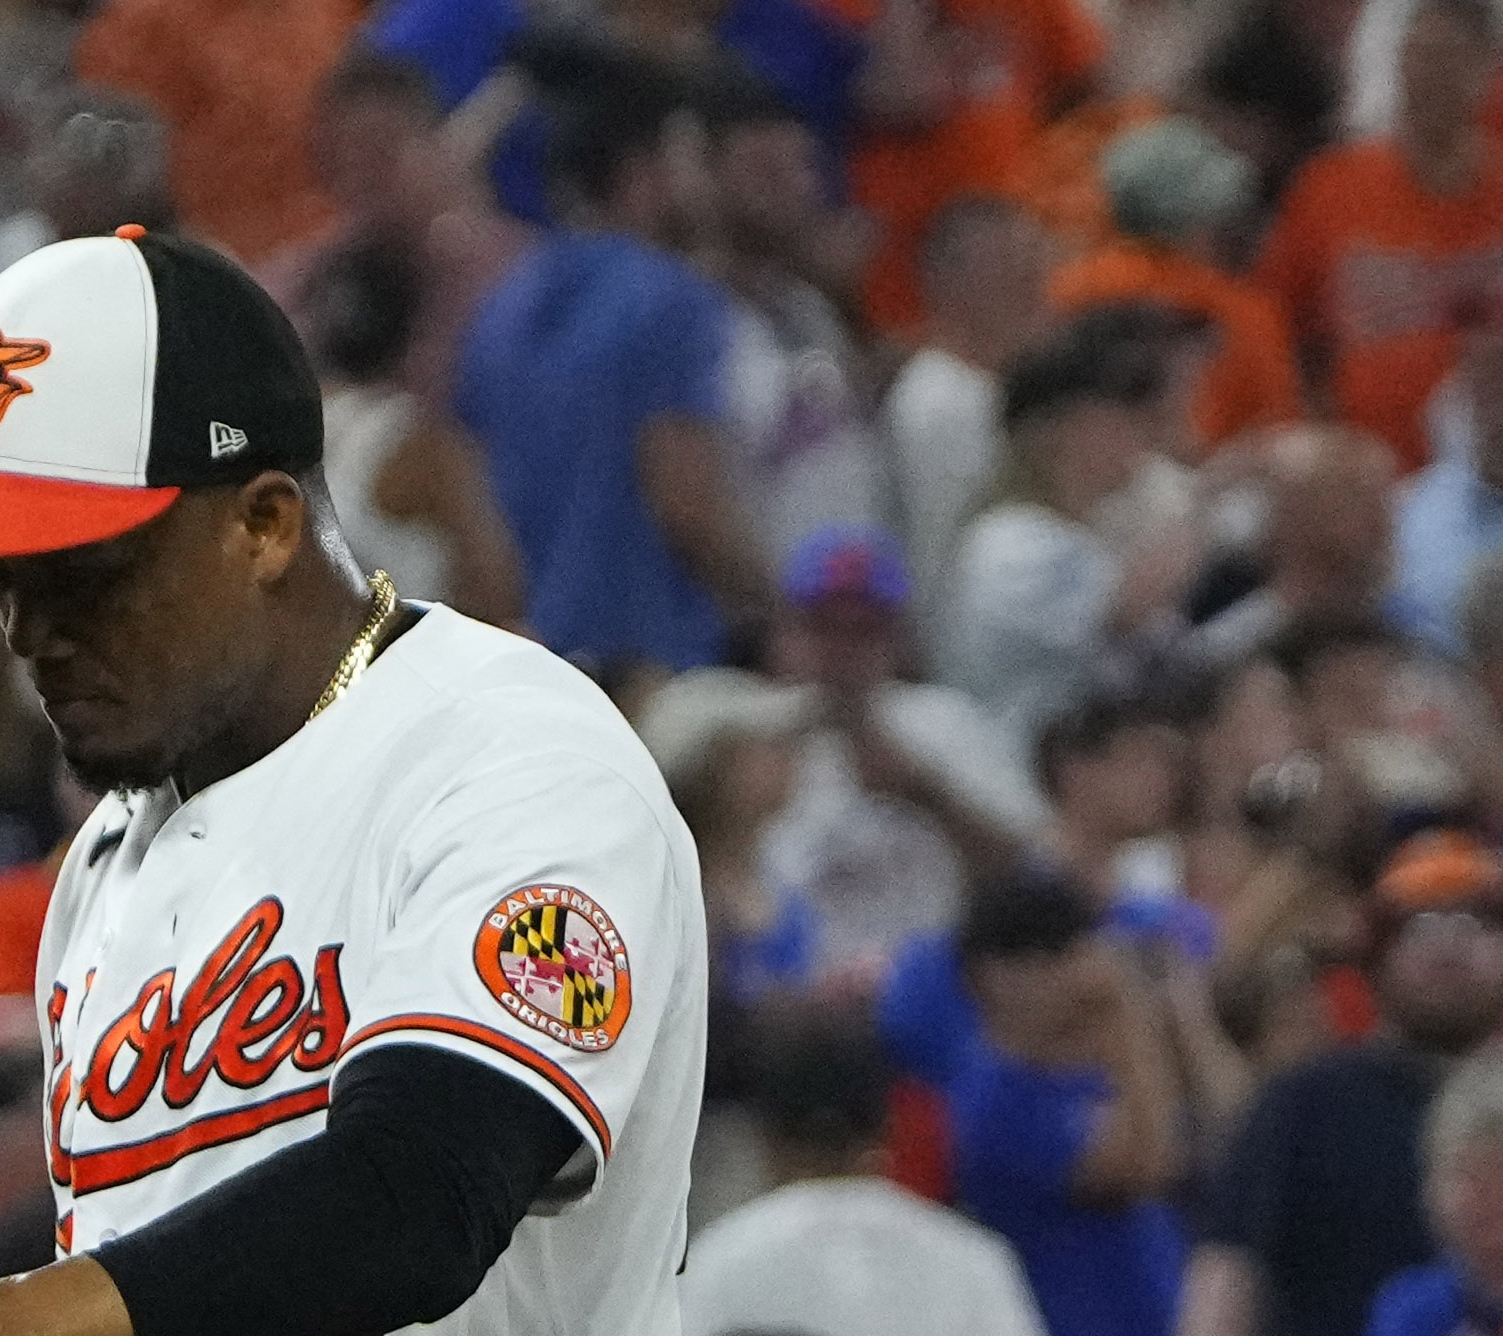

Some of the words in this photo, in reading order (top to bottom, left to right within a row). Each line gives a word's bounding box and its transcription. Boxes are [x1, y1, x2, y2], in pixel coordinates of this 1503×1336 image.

[487, 888, 628, 971] BALTIMORE
[48, 894, 350, 1122] oles
[501, 991, 609, 1047] ORIOLES
